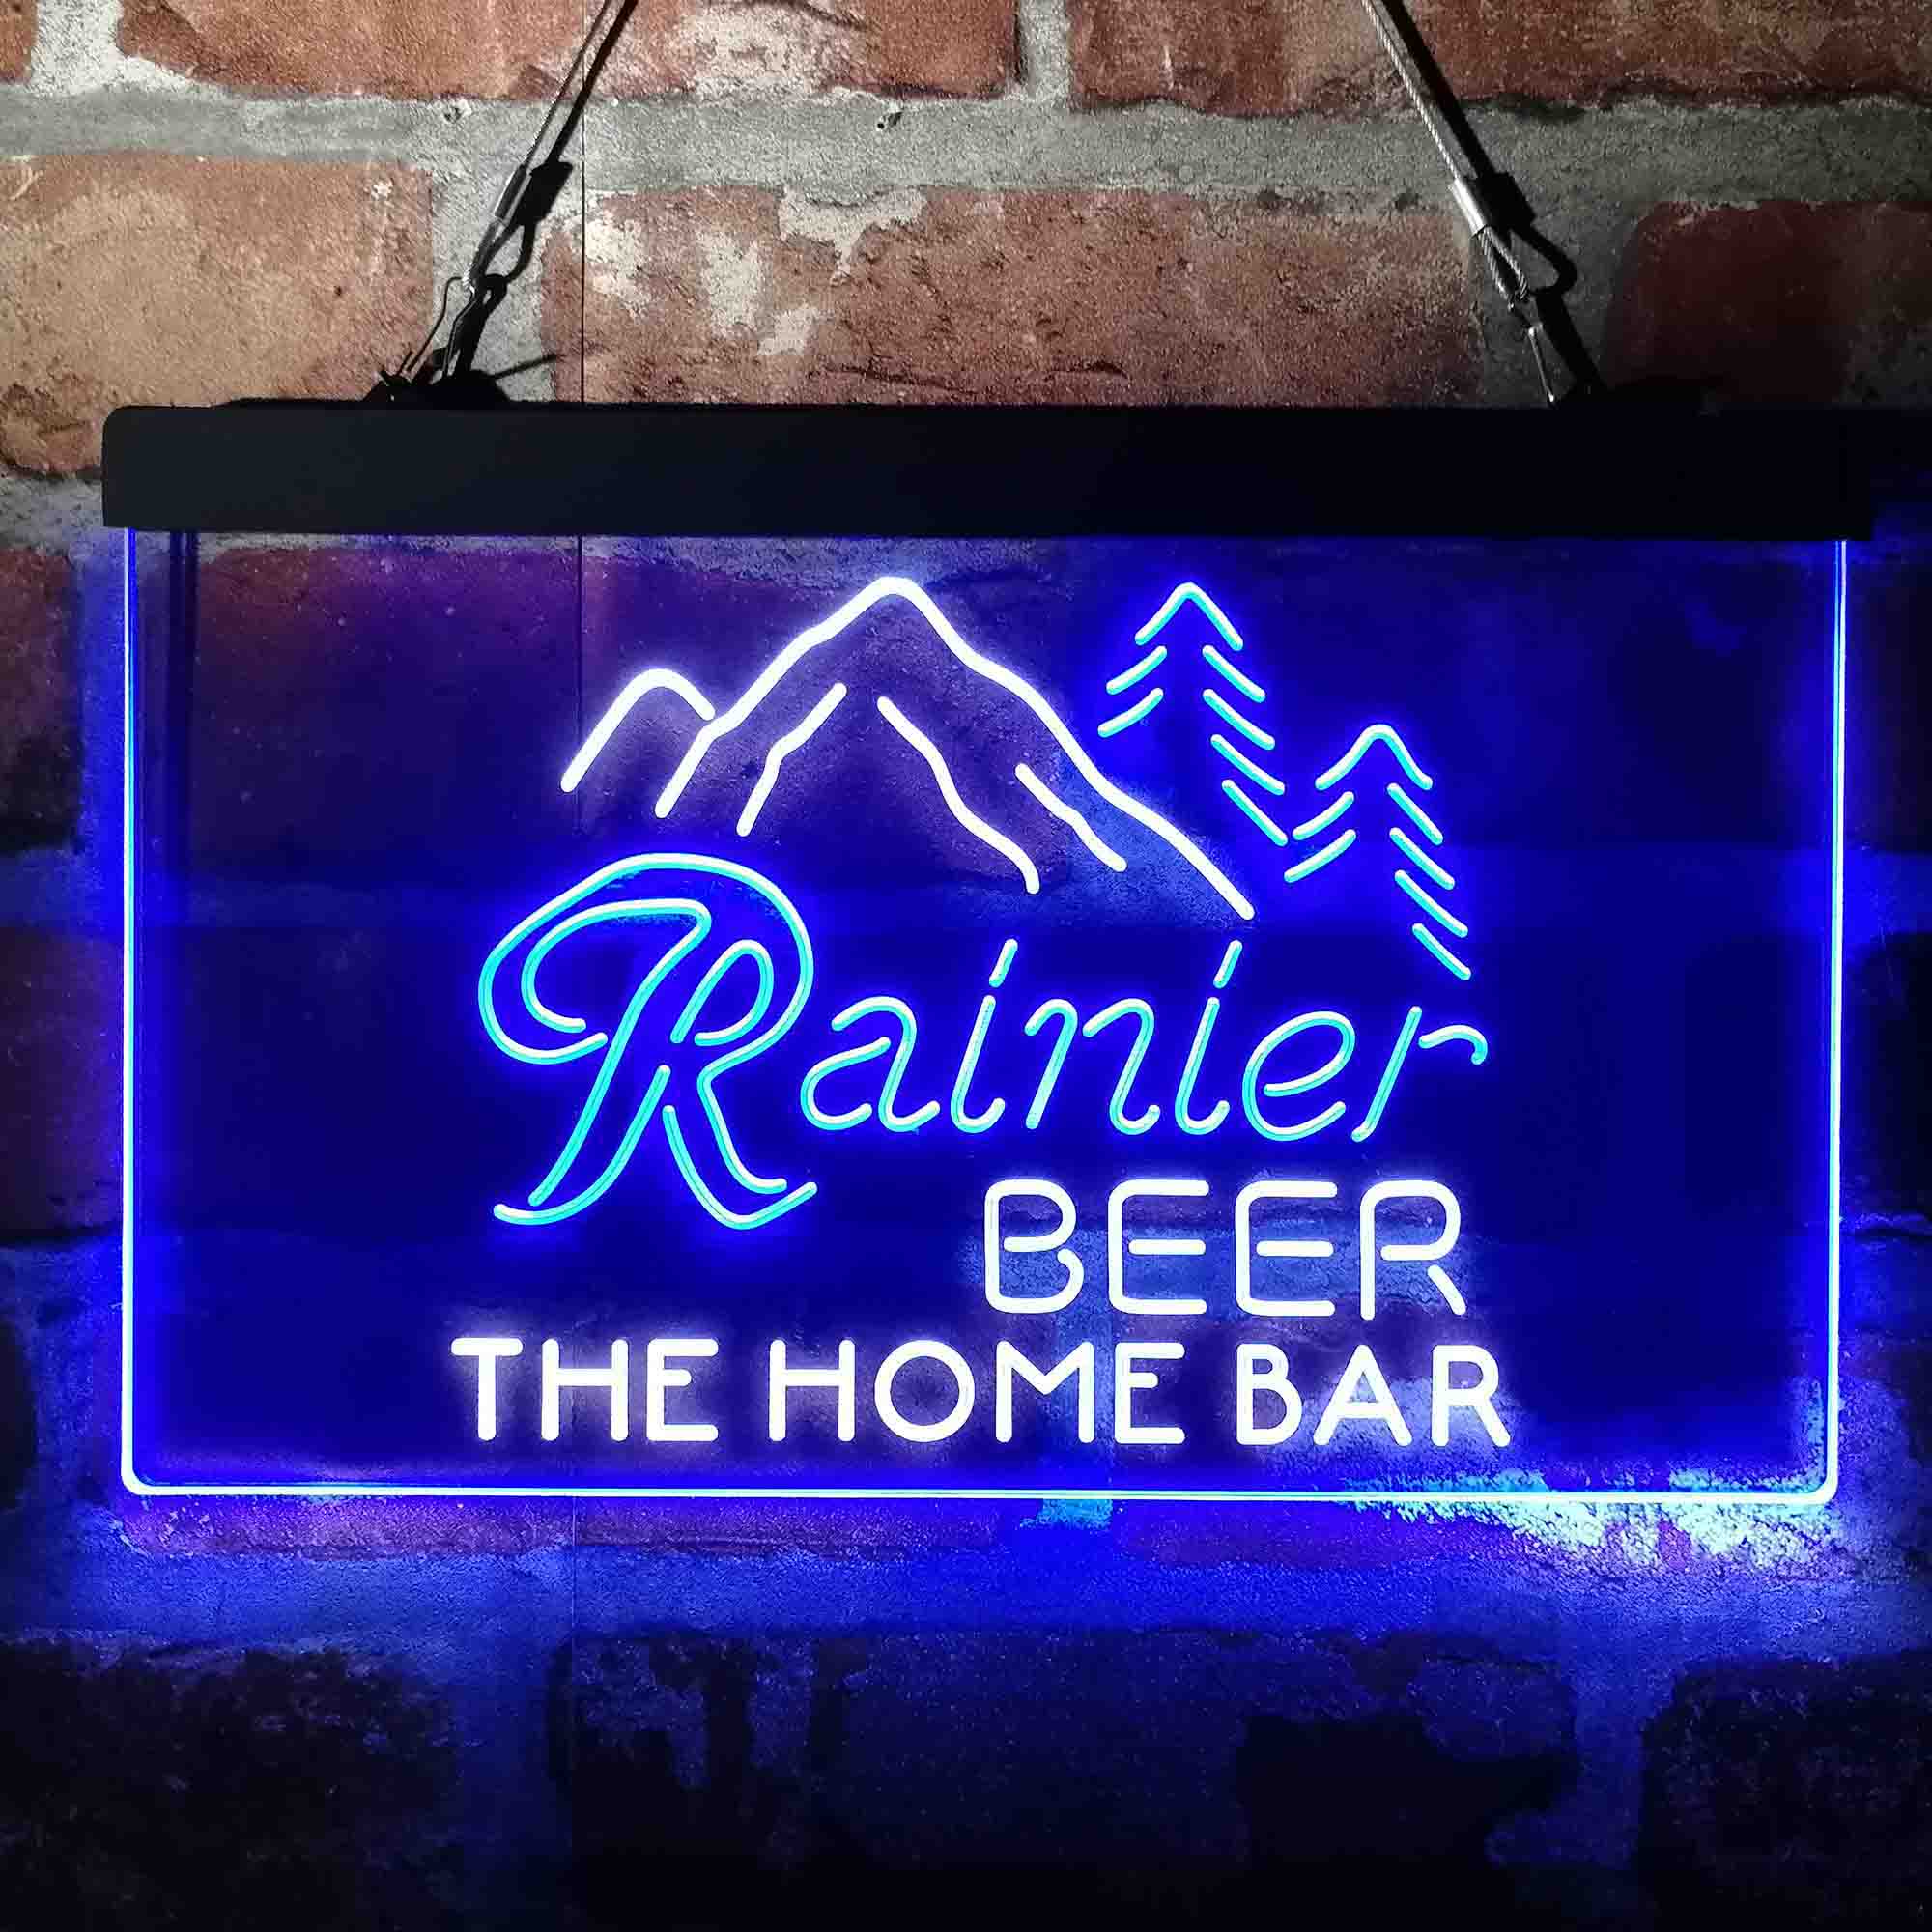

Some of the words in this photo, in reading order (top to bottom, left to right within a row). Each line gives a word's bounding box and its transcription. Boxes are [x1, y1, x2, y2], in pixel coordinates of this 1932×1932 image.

[477, 852, 1488, 1230] Rainier
[984, 1178, 1466, 1320] BEER
[451, 1337, 719, 1442] THE
[768, 1339, 1186, 1445] HOME
[1236, 1343, 1511, 1448] BAR
